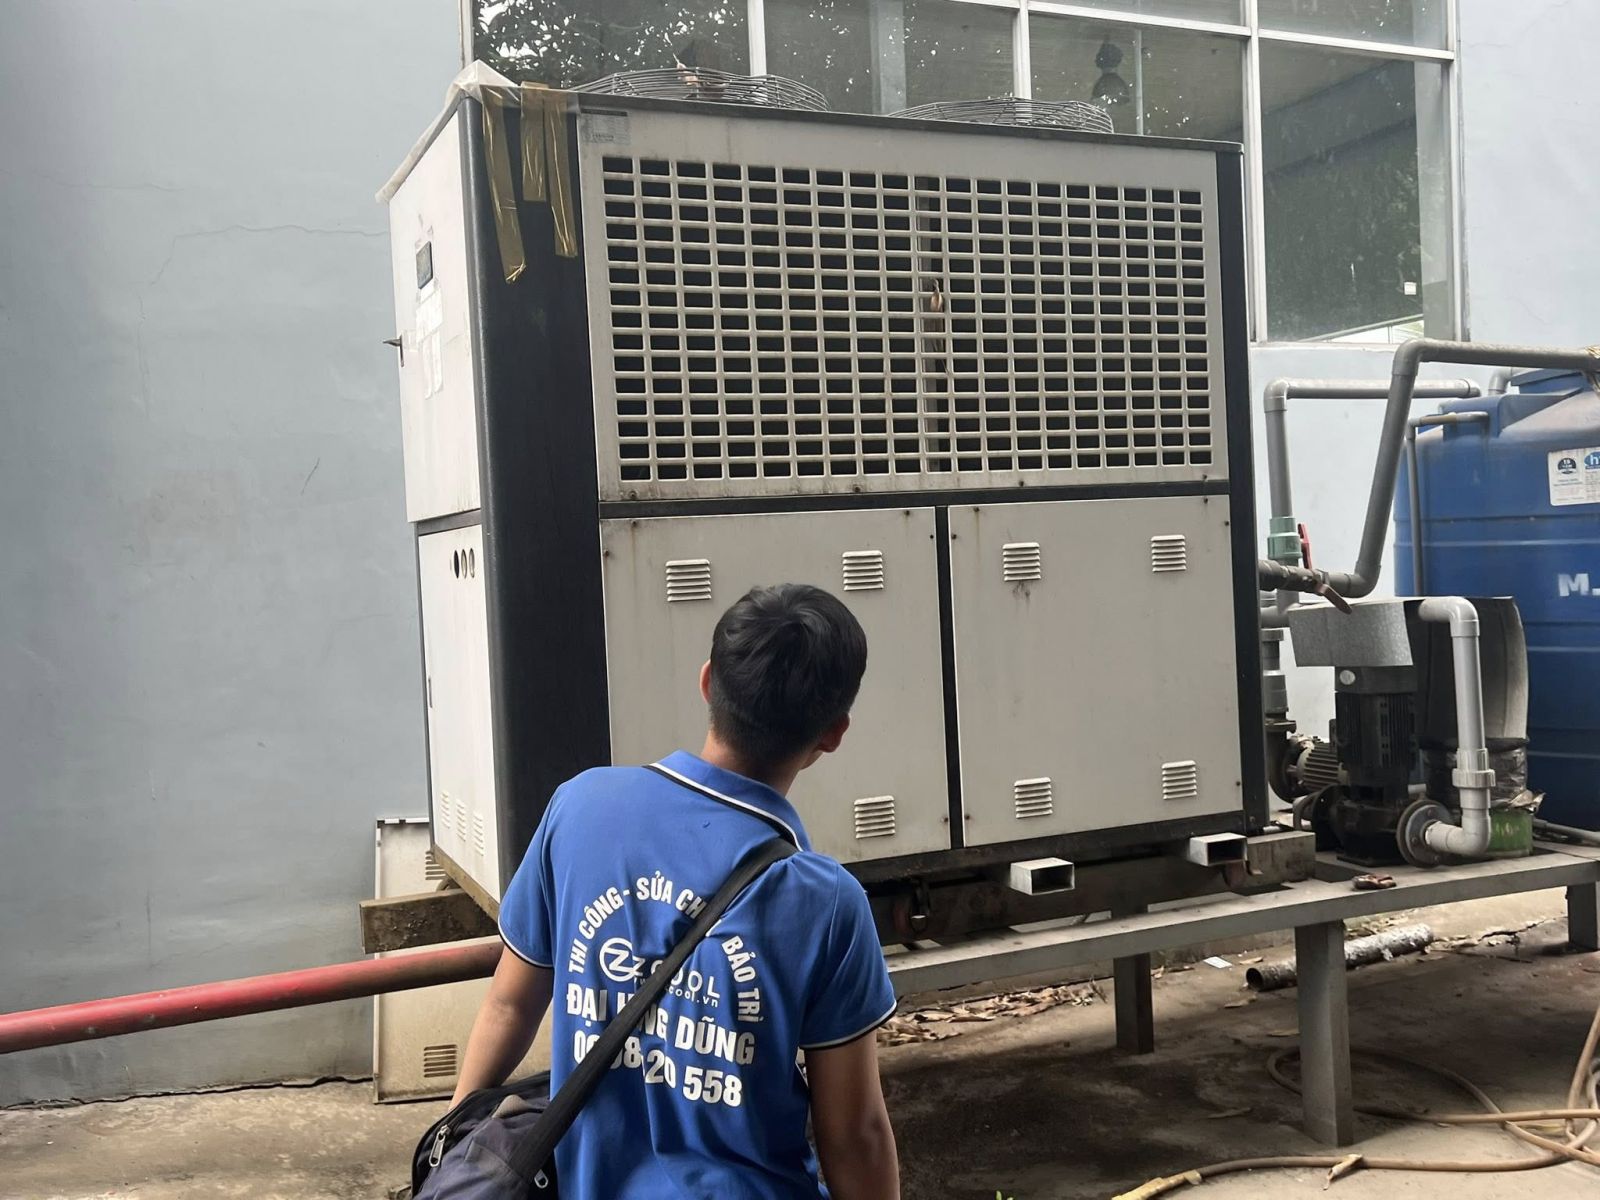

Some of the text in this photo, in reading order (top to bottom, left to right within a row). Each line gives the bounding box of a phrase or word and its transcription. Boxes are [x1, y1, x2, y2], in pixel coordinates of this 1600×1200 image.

[636, 870, 673, 905] SỬA
[675, 888, 708, 919] CH
[568, 938, 588, 974] THI
[721, 935, 756, 983] BẢO
[737, 987, 764, 1022] TRÌ
[566, 983, 608, 1027] ĐẠI
[674, 1015, 755, 1065] DŨNG
[682, 1065, 743, 1107] 558
